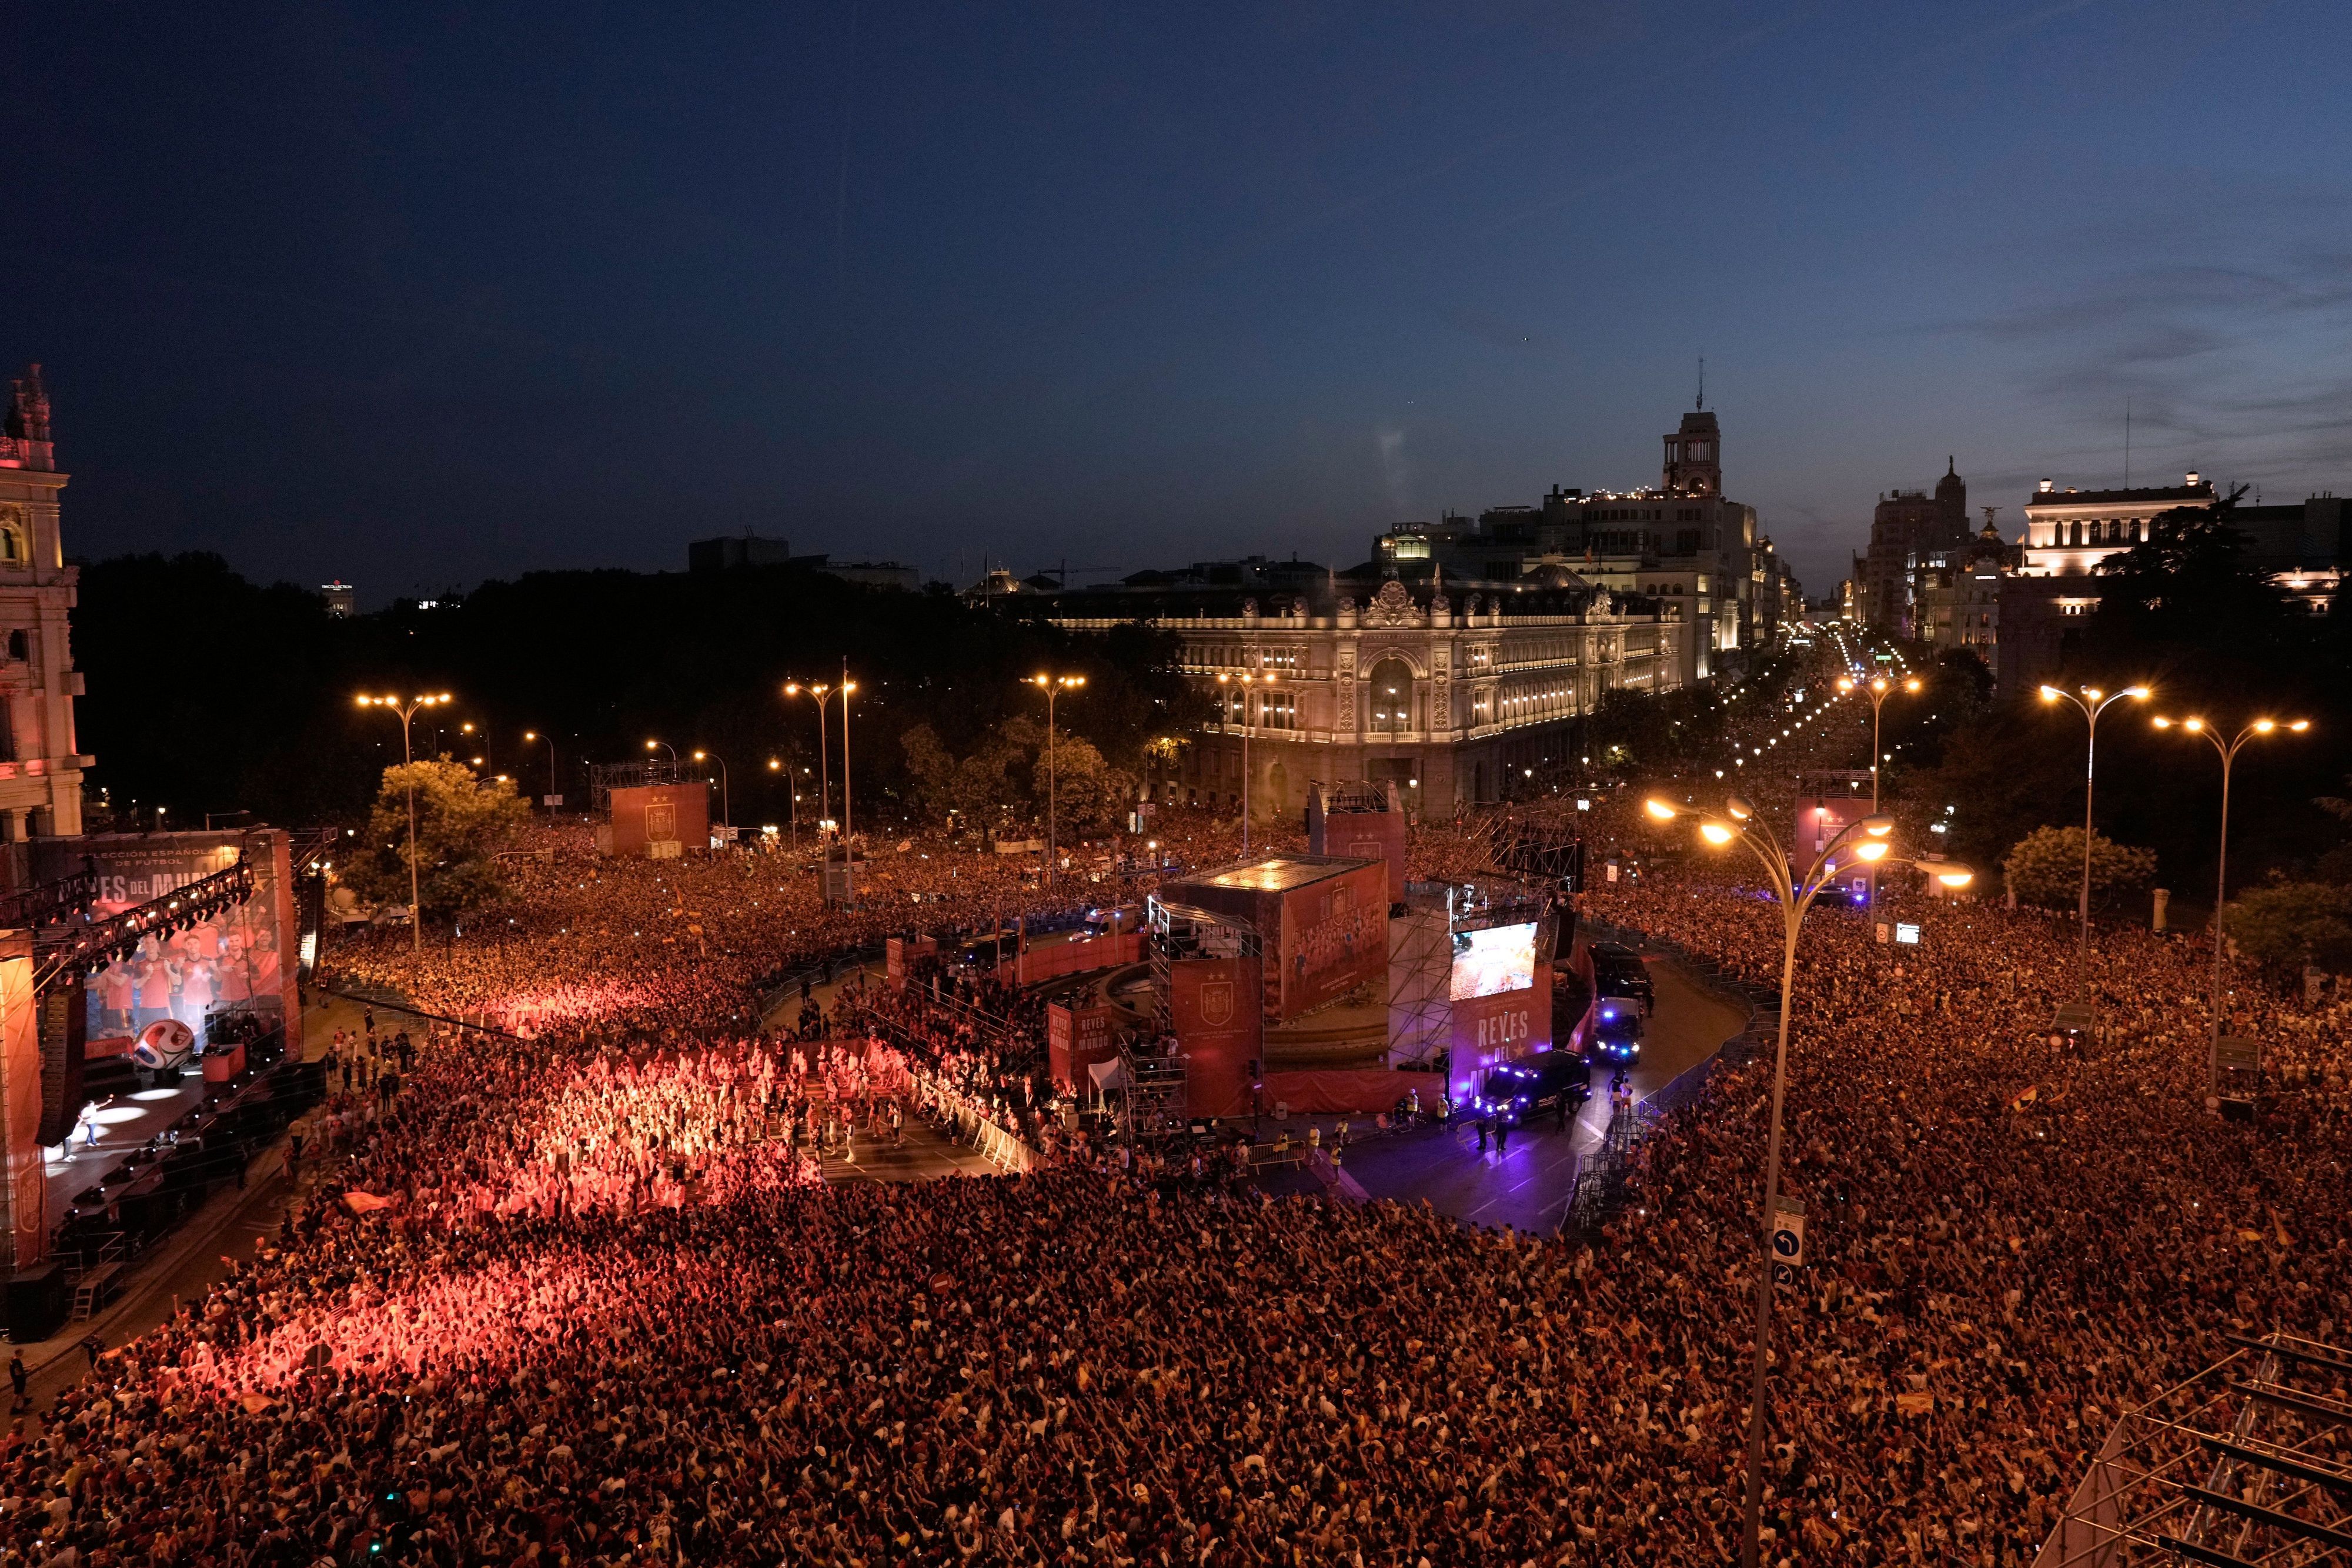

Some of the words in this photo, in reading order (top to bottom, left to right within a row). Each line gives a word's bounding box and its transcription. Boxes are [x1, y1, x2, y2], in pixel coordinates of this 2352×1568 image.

[77, 850, 146, 860] SLECCIÓN
[136, 858, 184, 867] FÚTBOL
[131, 881, 150, 895] DEL
[1082, 1017, 1105, 1031] REYES
[1478, 1011, 1528, 1047] REYES
[1078, 1035, 1108, 1051] MUNDO
[1494, 1045, 1510, 1063] DEL
